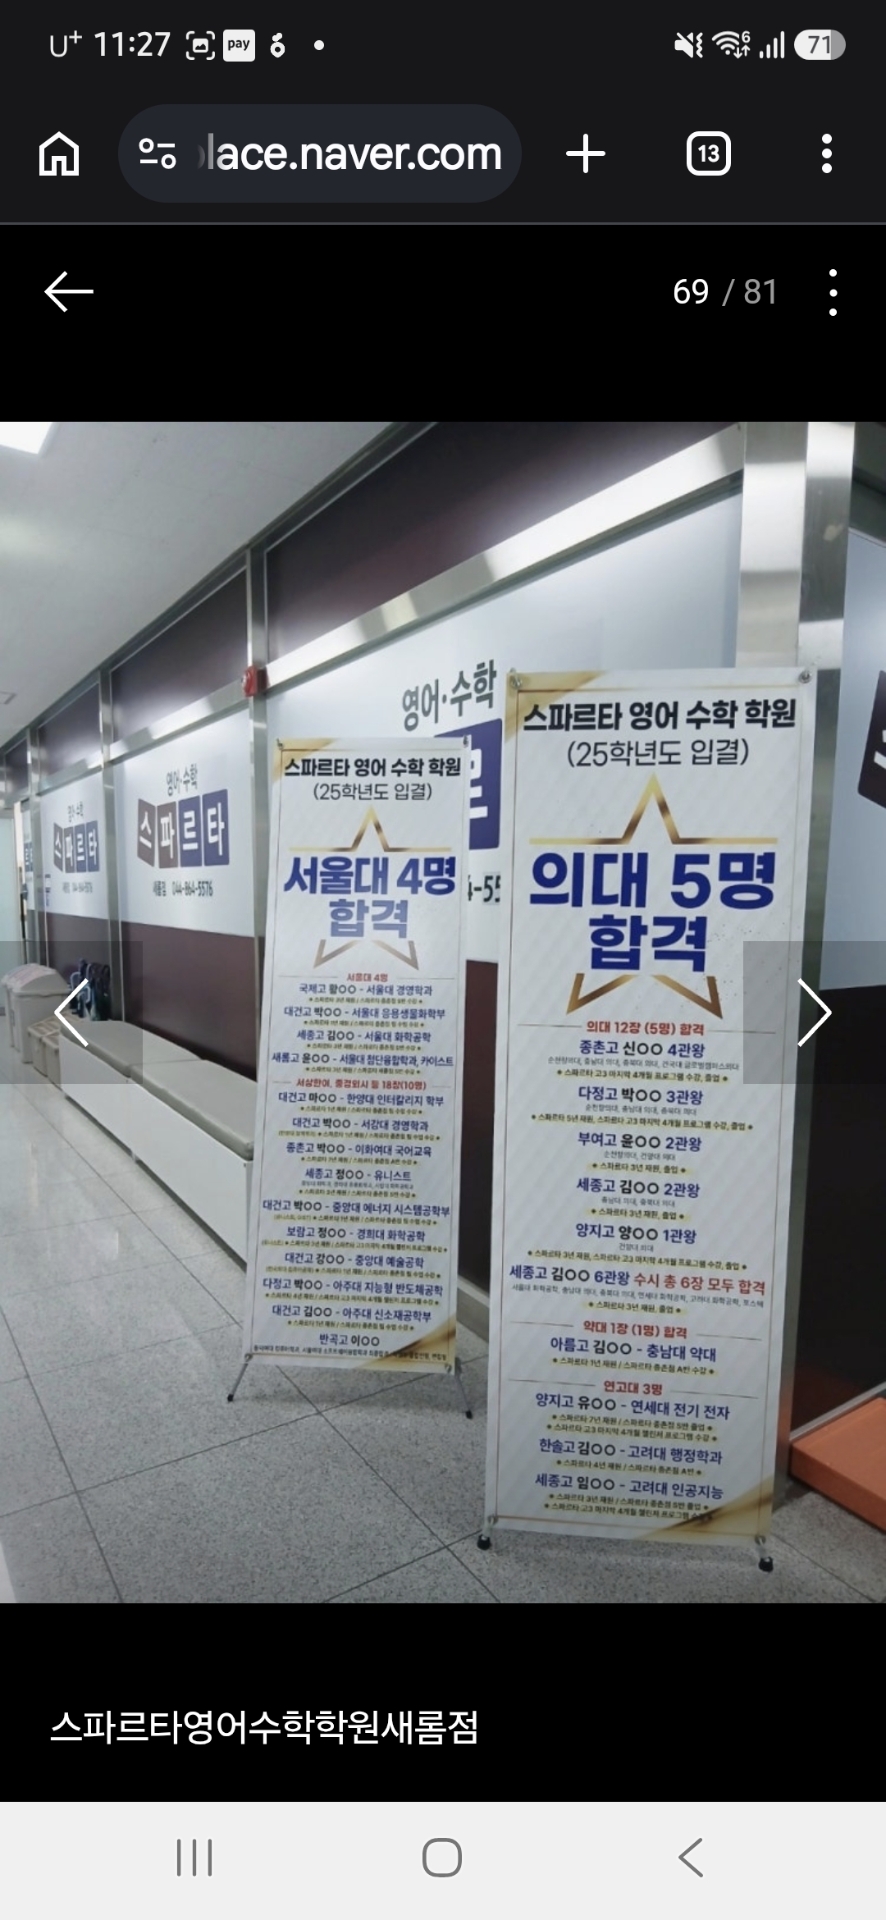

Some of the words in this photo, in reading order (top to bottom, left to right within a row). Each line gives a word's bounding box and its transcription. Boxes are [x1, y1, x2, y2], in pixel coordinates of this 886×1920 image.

[522, 701, 622, 730] 스파르타
[629, 702, 678, 729] 영어
[686, 700, 738, 728] 수학
[745, 699, 795, 727] 학원
[567, 741, 681, 766] (25학년도
[691, 739, 748, 764] 입결)
[284, 758, 350, 775] 스파르타
[354, 758, 385, 776] 영어
[391, 758, 424, 776] 수학
[428, 758, 460, 775] 학원
[313, 783, 388, 799] (25학년도
[394, 783, 431, 799] 입결)
[139, 802, 225, 859] 스파르타
[283, 857, 388, 893] 서울대
[396, 857, 455, 894] 4명
[530, 853, 647, 905] 의대
[670, 853, 775, 908] 5명
[329, 899, 407, 936] 합격
[589, 915, 706, 970] 합격
[586, 1020, 610, 1032] 의대
[614, 1021, 641, 1033] 12장
[644, 1022, 676, 1034] (5명)
[680, 1023, 704, 1035] 합격
[579, 1040, 618, 1054] 종촌고
[667, 1043, 705, 1058] 4관왕
[578, 1086, 617, 1100] 다정고
[666, 1090, 703, 1105] 3관왕
[578, 1132, 616, 1146] 부여고
[665, 1136, 702, 1151] 2관왕
[576, 1177, 615, 1192] 세종고
[663, 1183, 700, 1198] 2관왕
[575, 1223, 614, 1237] 양지고
[662, 1229, 696, 1244] 1관왕
[509, 1265, 547, 1279] 세종고
[594, 1270, 630, 1285] 6관왕
[634, 1272, 659, 1287] 수시
[664, 1274, 676, 1288] 총
[680, 1276, 704, 1290] 6장
[707, 1277, 734, 1292] 모두
[738, 1280, 765, 1295] 합격
[583, 1320, 607, 1332] 약대
[610, 1322, 628, 1334] 1장
[631, 1324, 660, 1336] (1명)
[663, 1326, 687, 1338] 합격
[550, 1337, 589, 1352] 아름고
[646, 1344, 685, 1359] 충남대
[689, 1347, 716, 1362] 약대
[603, 1380, 639, 1393] 연고대
[642, 1383, 662, 1395] 3명
[535, 1393, 574, 1407] 양지고
[630, 1400, 669, 1415] 연세대
[673, 1403, 699, 1417] 전기
[703, 1405, 730, 1419] 전자
[539, 1438, 575, 1453] 한솔고
[627, 1445, 666, 1460] 고려대
[670, 1448, 722, 1464] 행정학과
[534, 1473, 572, 1487] 세종고
[629, 1480, 667, 1495] 고려대
[671, 1483, 723, 1499] 인공지능
